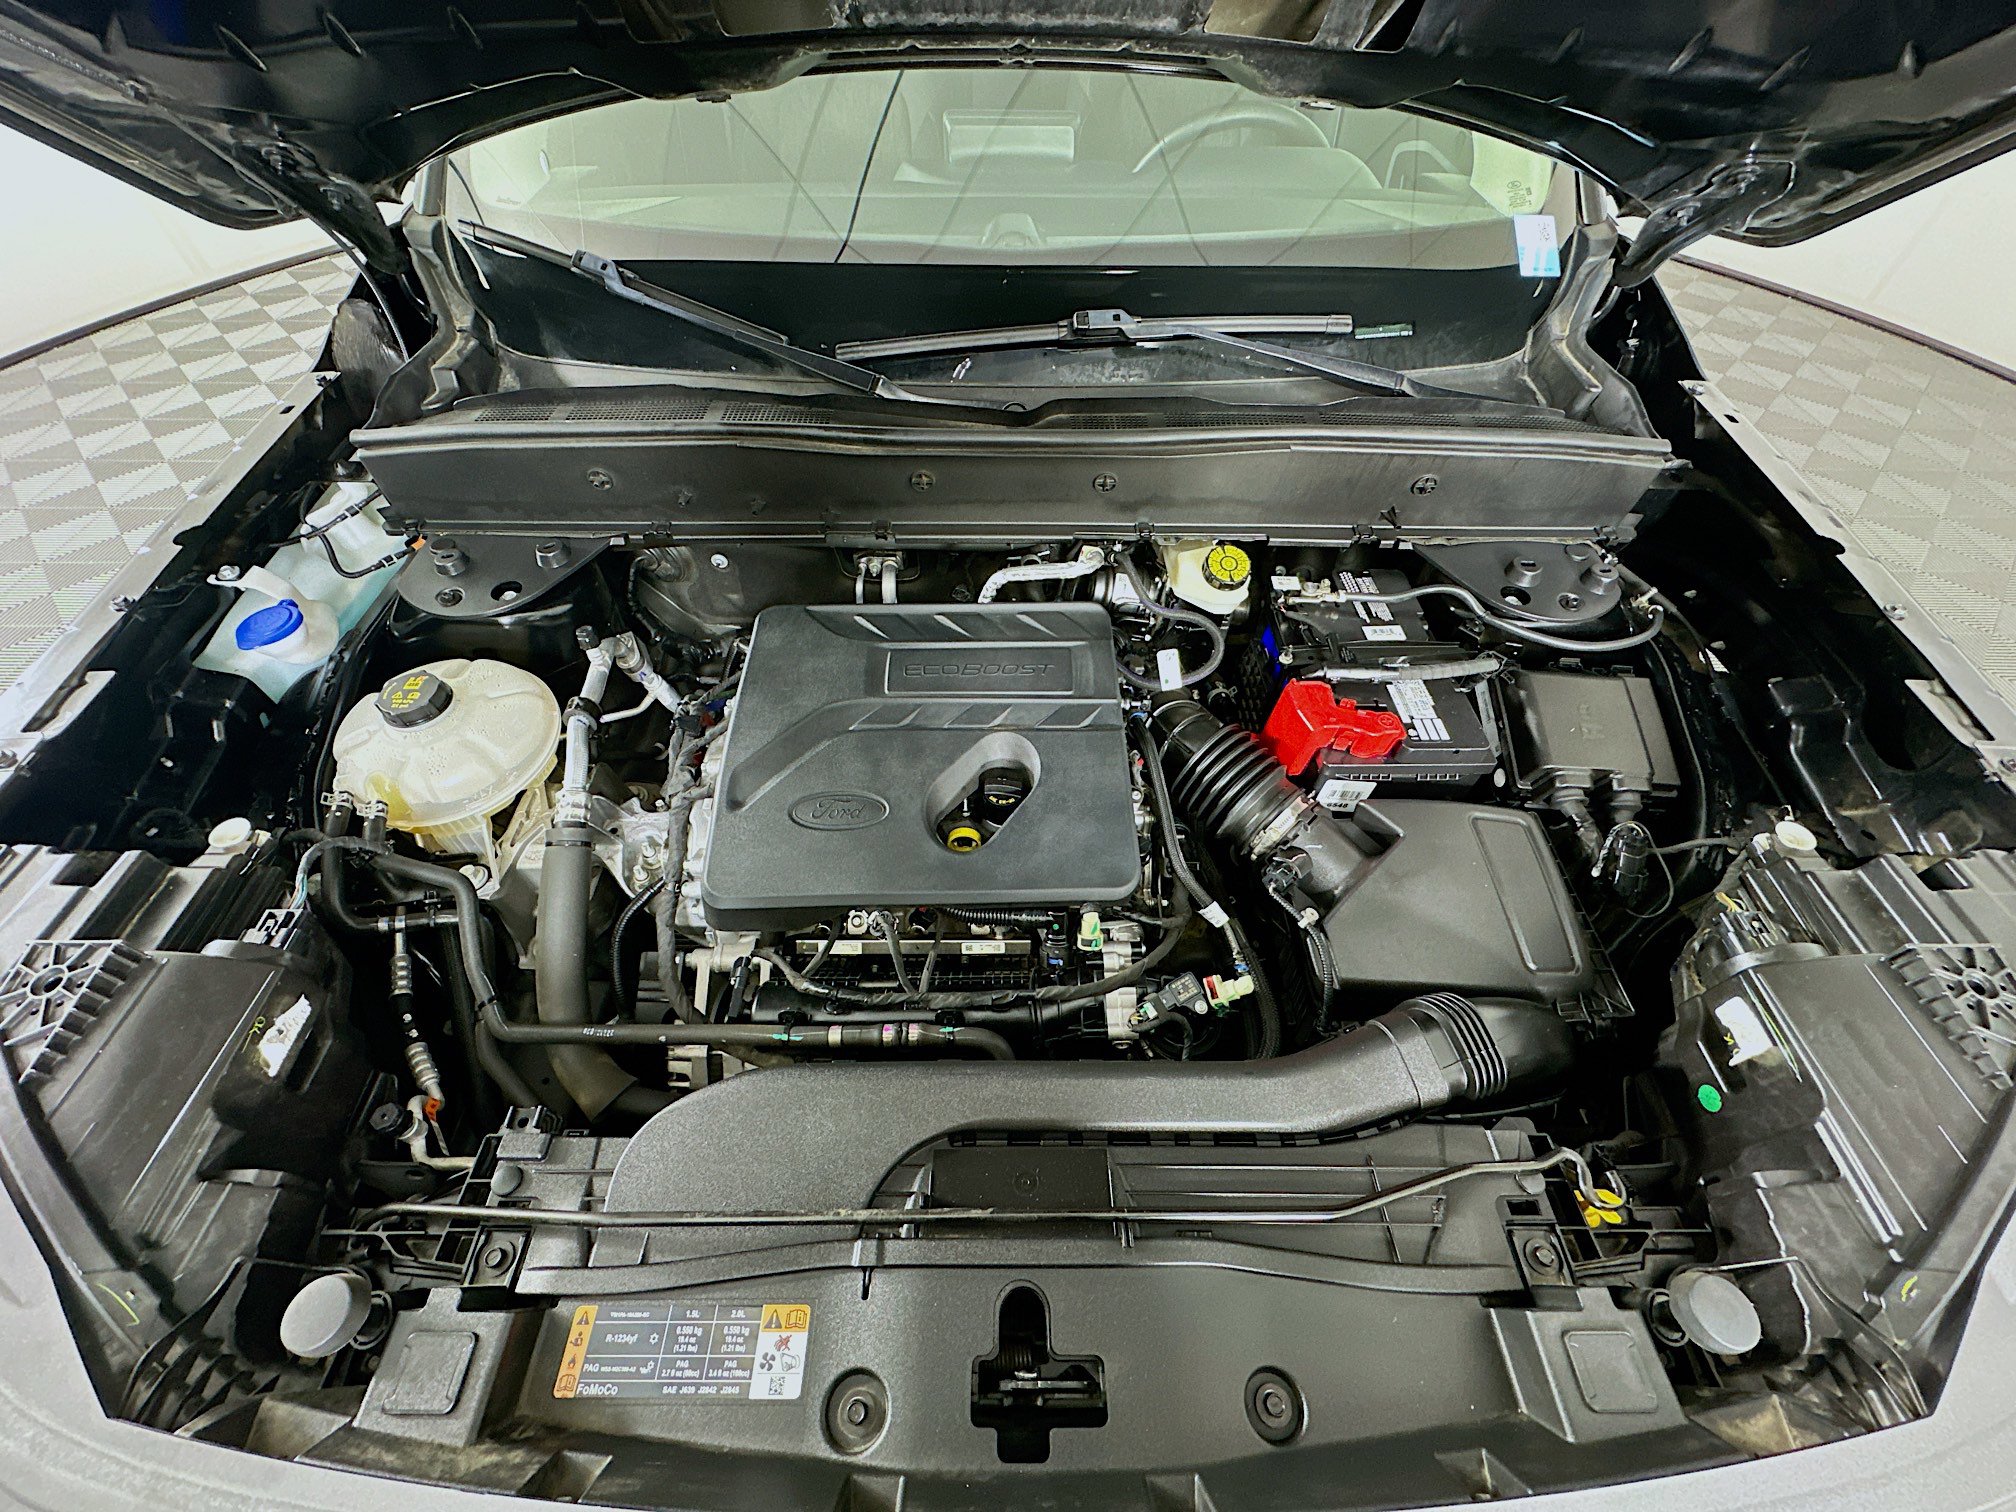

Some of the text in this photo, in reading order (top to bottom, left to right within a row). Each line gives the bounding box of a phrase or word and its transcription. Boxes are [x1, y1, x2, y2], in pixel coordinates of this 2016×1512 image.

[904, 664, 1055, 677] ECOBOOST
[811, 799, 866, 819] Ford
[741, 1325, 750, 1337] kg
[605, 1333, 639, 1345] R-1234yf
[582, 1363, 600, 1373] PAG
[675, 1360, 689, 1368] PAG
[723, 1360, 738, 1368] PAG
[576, 1383, 618, 1396] FoMoCo
[662, 1386, 677, 1394] SAE
[679, 1386, 696, 1394] J639
